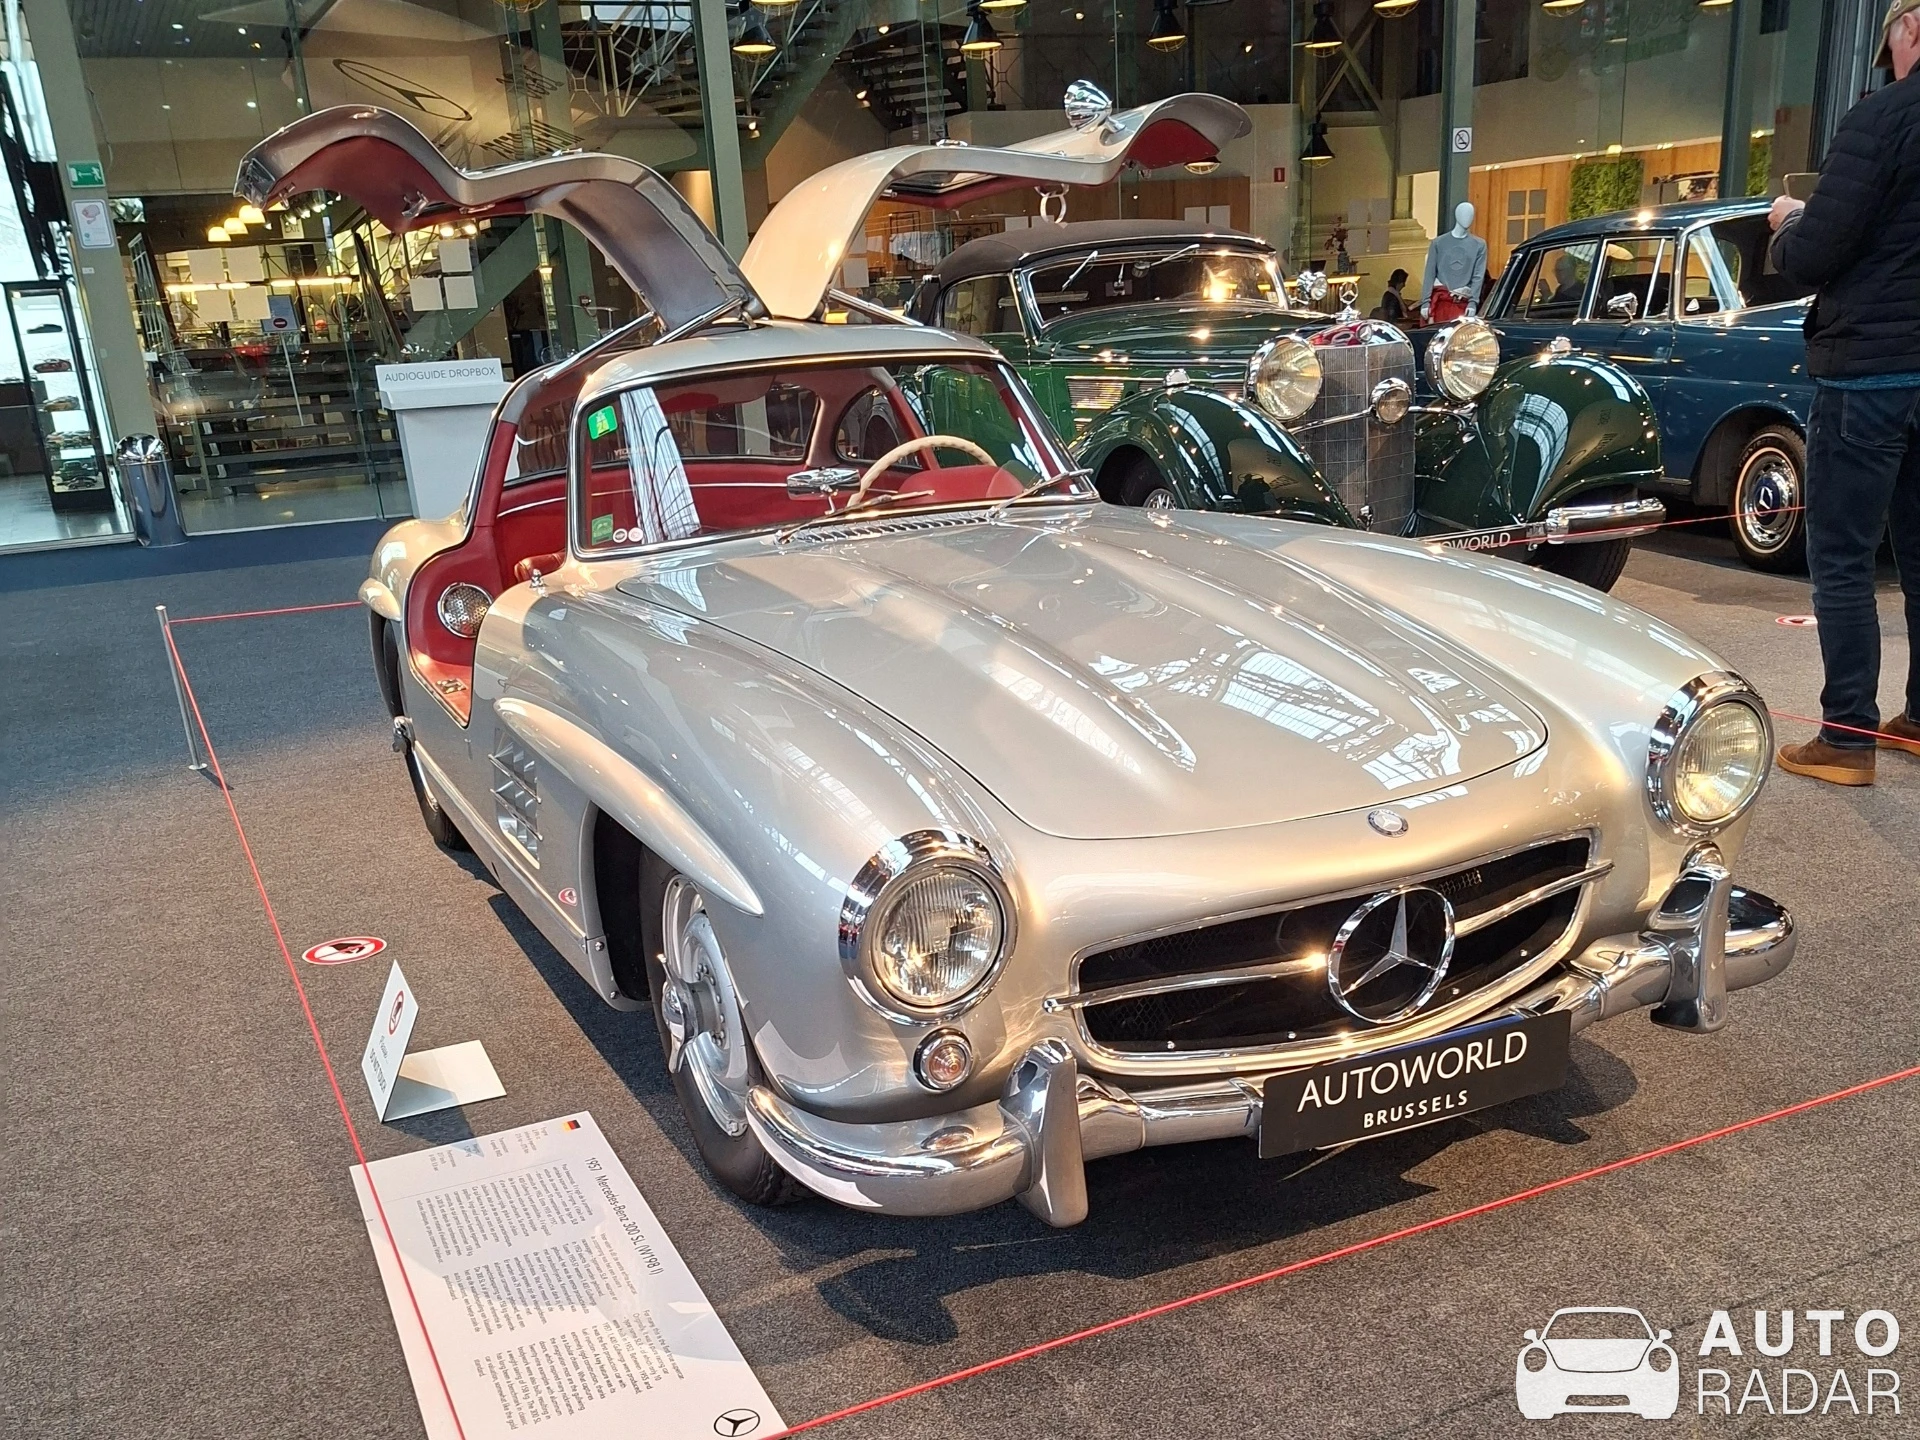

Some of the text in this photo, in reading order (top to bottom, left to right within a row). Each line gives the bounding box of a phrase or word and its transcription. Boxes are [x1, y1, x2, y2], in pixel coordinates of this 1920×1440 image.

[385, 366, 496, 382] AUDIOGUIDE DROPBOX
[1297, 1031, 1528, 1113] AUTOWORLD
[1363, 1090, 1468, 1128] BRUSSELS
[584, 1156, 602, 1172] 1957
[595, 1174, 629, 1222] Mercedes-Benz
[623, 1221, 640, 1235] 300
[630, 1234, 646, 1245] SL
[635, 1244, 660, 1268] (W198
